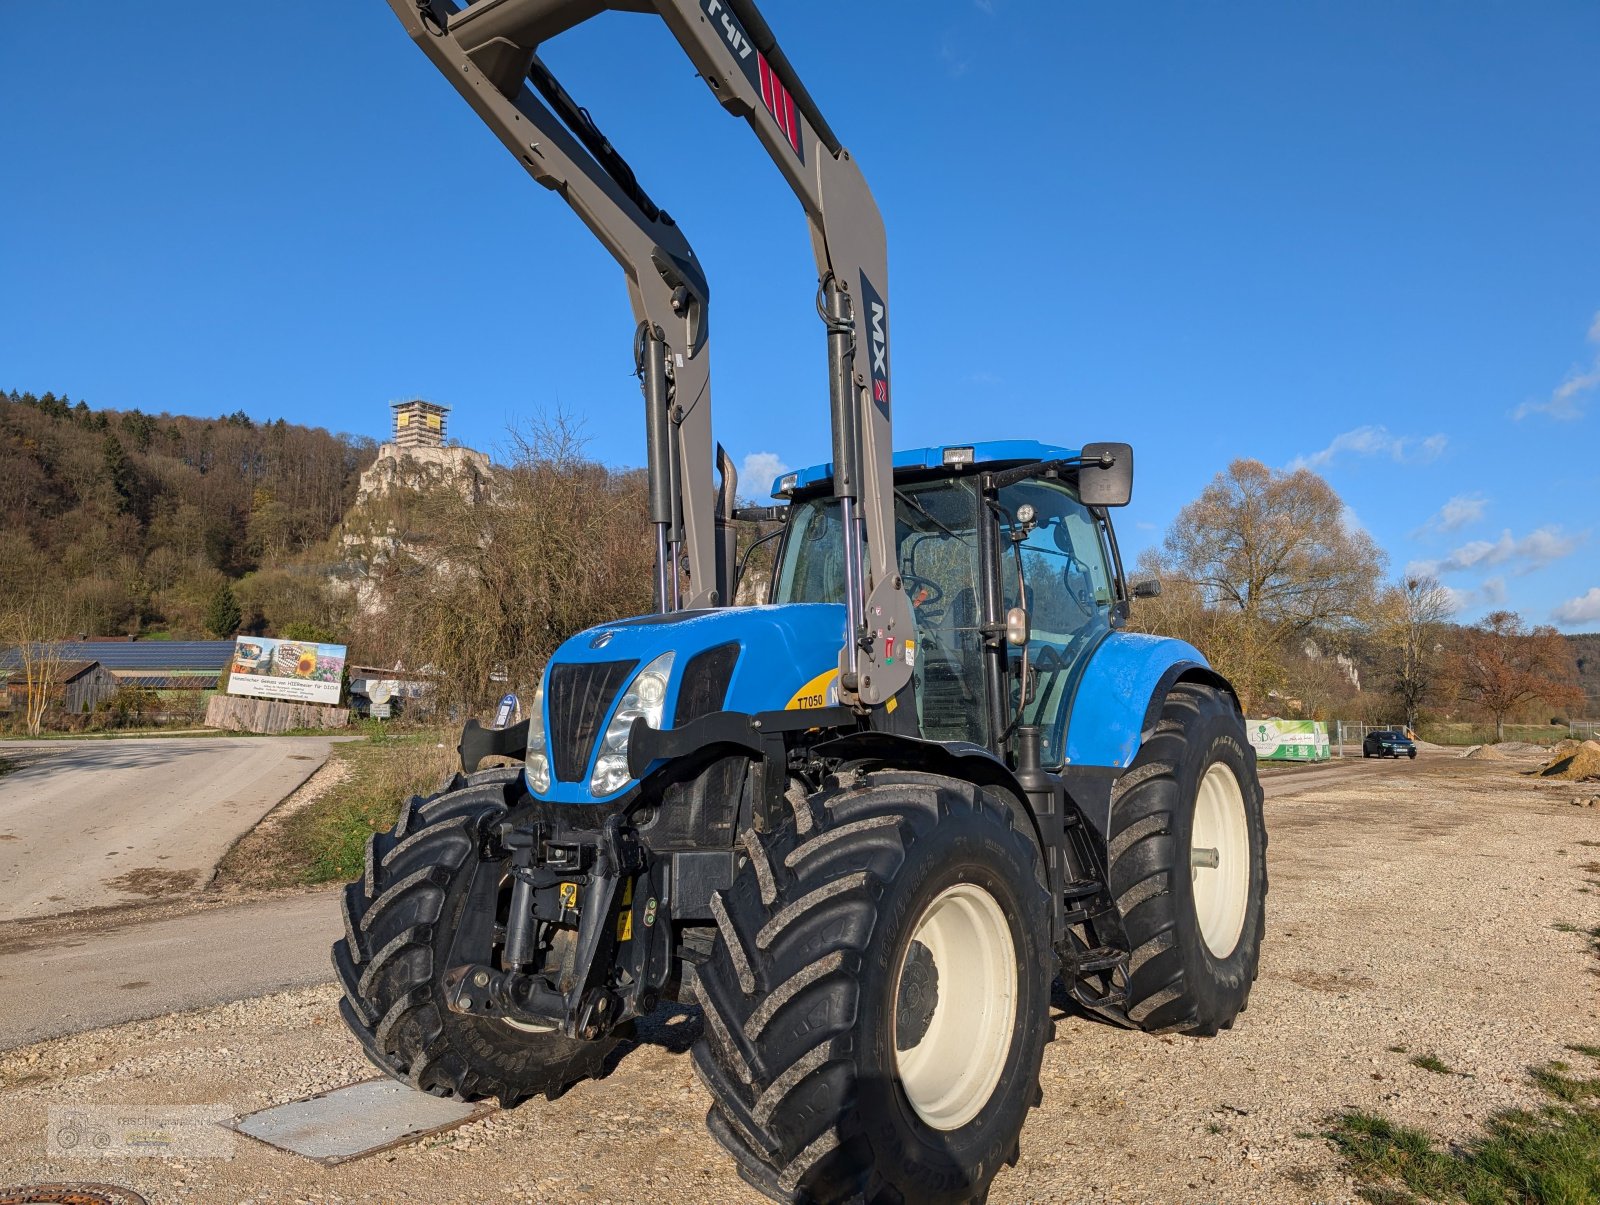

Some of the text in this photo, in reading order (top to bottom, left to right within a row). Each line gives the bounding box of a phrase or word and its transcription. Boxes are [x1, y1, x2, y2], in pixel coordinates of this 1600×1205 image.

[721, 13, 753, 59] 417
[871, 302, 886, 377] MX
[798, 695, 823, 710] T7050
